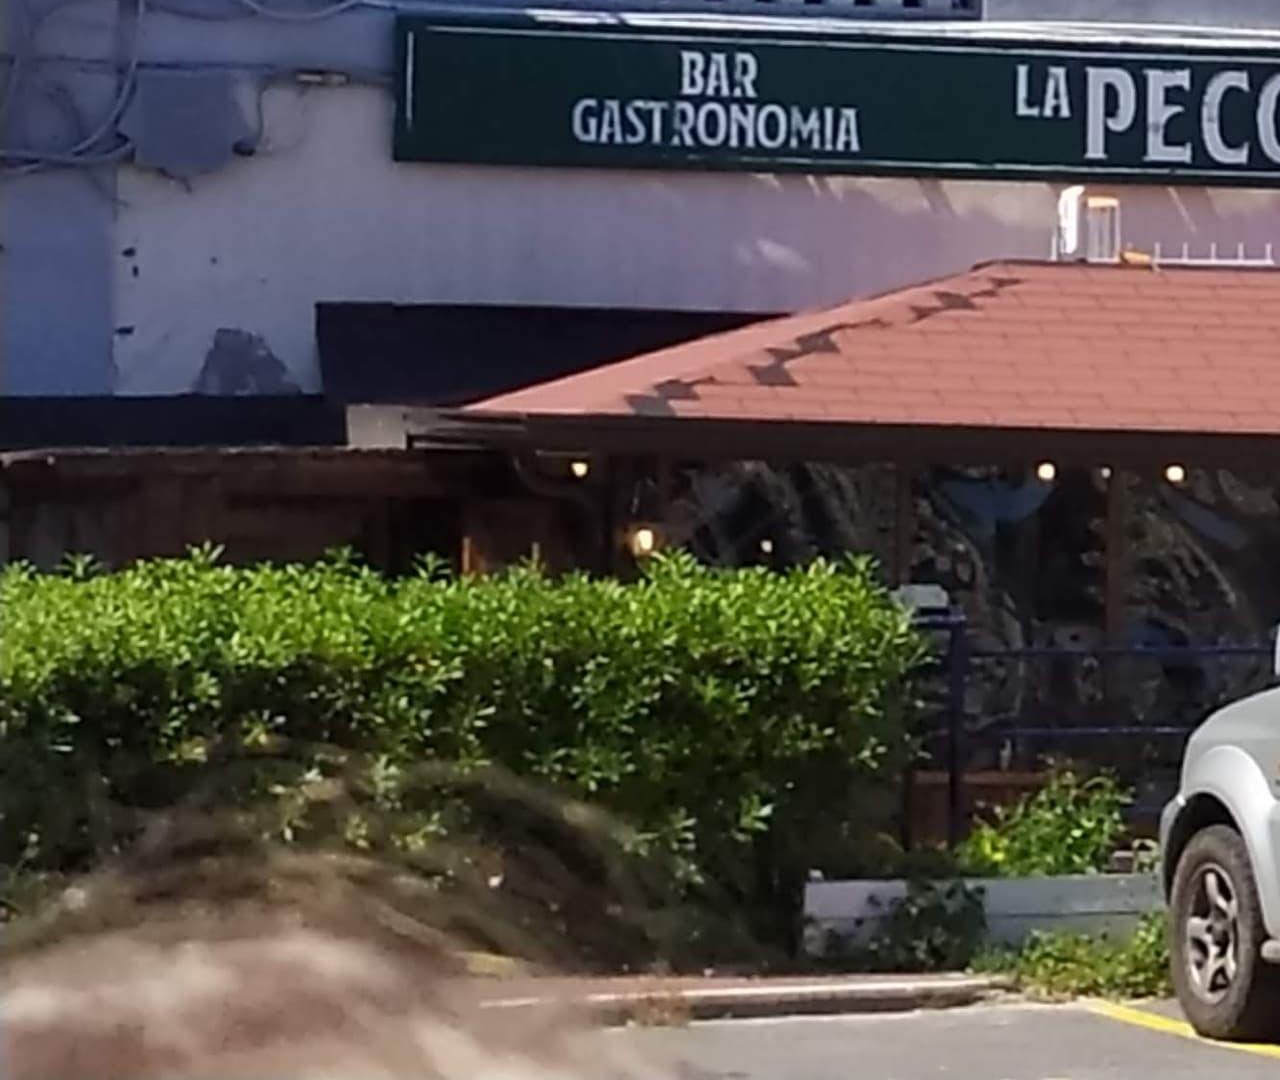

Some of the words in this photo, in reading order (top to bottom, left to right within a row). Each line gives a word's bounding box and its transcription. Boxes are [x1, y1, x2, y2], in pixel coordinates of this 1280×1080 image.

[681, 50, 757, 98] BAR
[1015, 63, 1072, 119] LA
[572, 98, 861, 153] GASTRONOMIA
